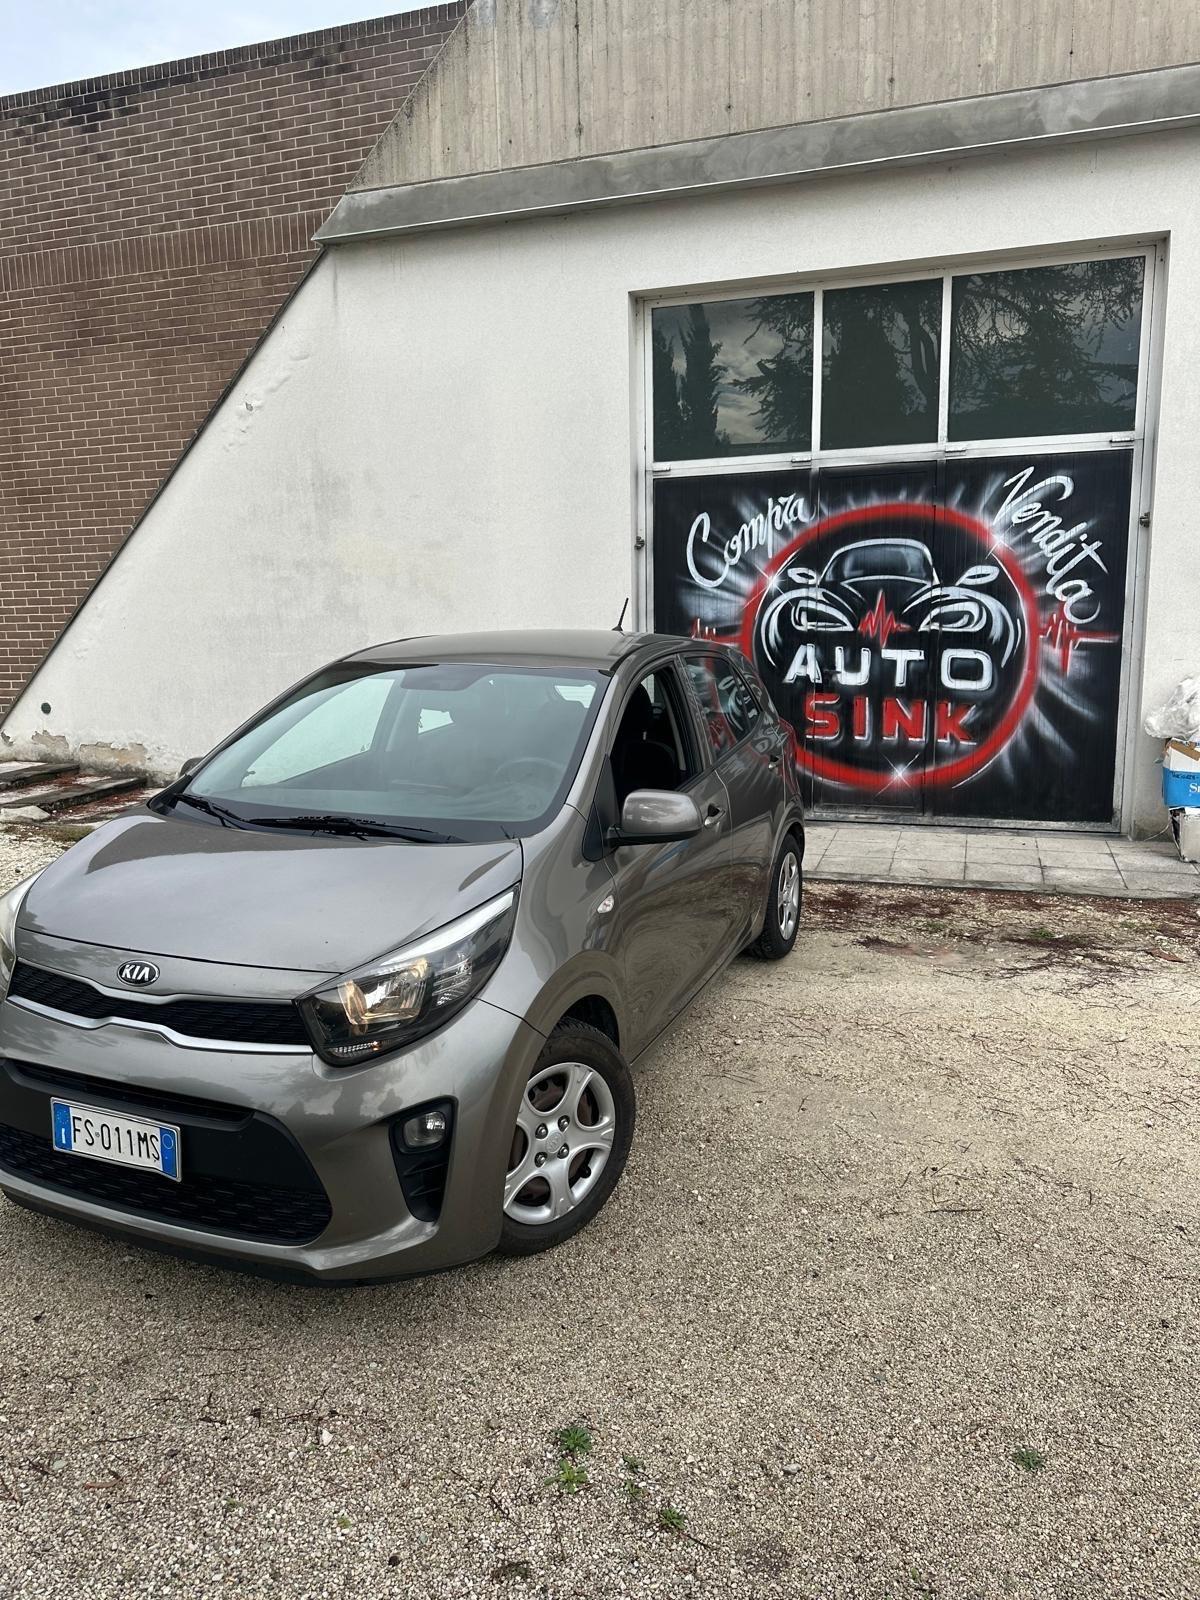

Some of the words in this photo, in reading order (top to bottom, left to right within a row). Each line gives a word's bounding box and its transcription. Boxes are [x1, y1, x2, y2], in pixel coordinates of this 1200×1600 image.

[686, 492, 817, 588] Compra
[993, 466, 1109, 624] Vendita
[782, 643, 993, 691] AUTO
[804, 692, 977, 745] SINK
[121, 964, 151, 981] KIA
